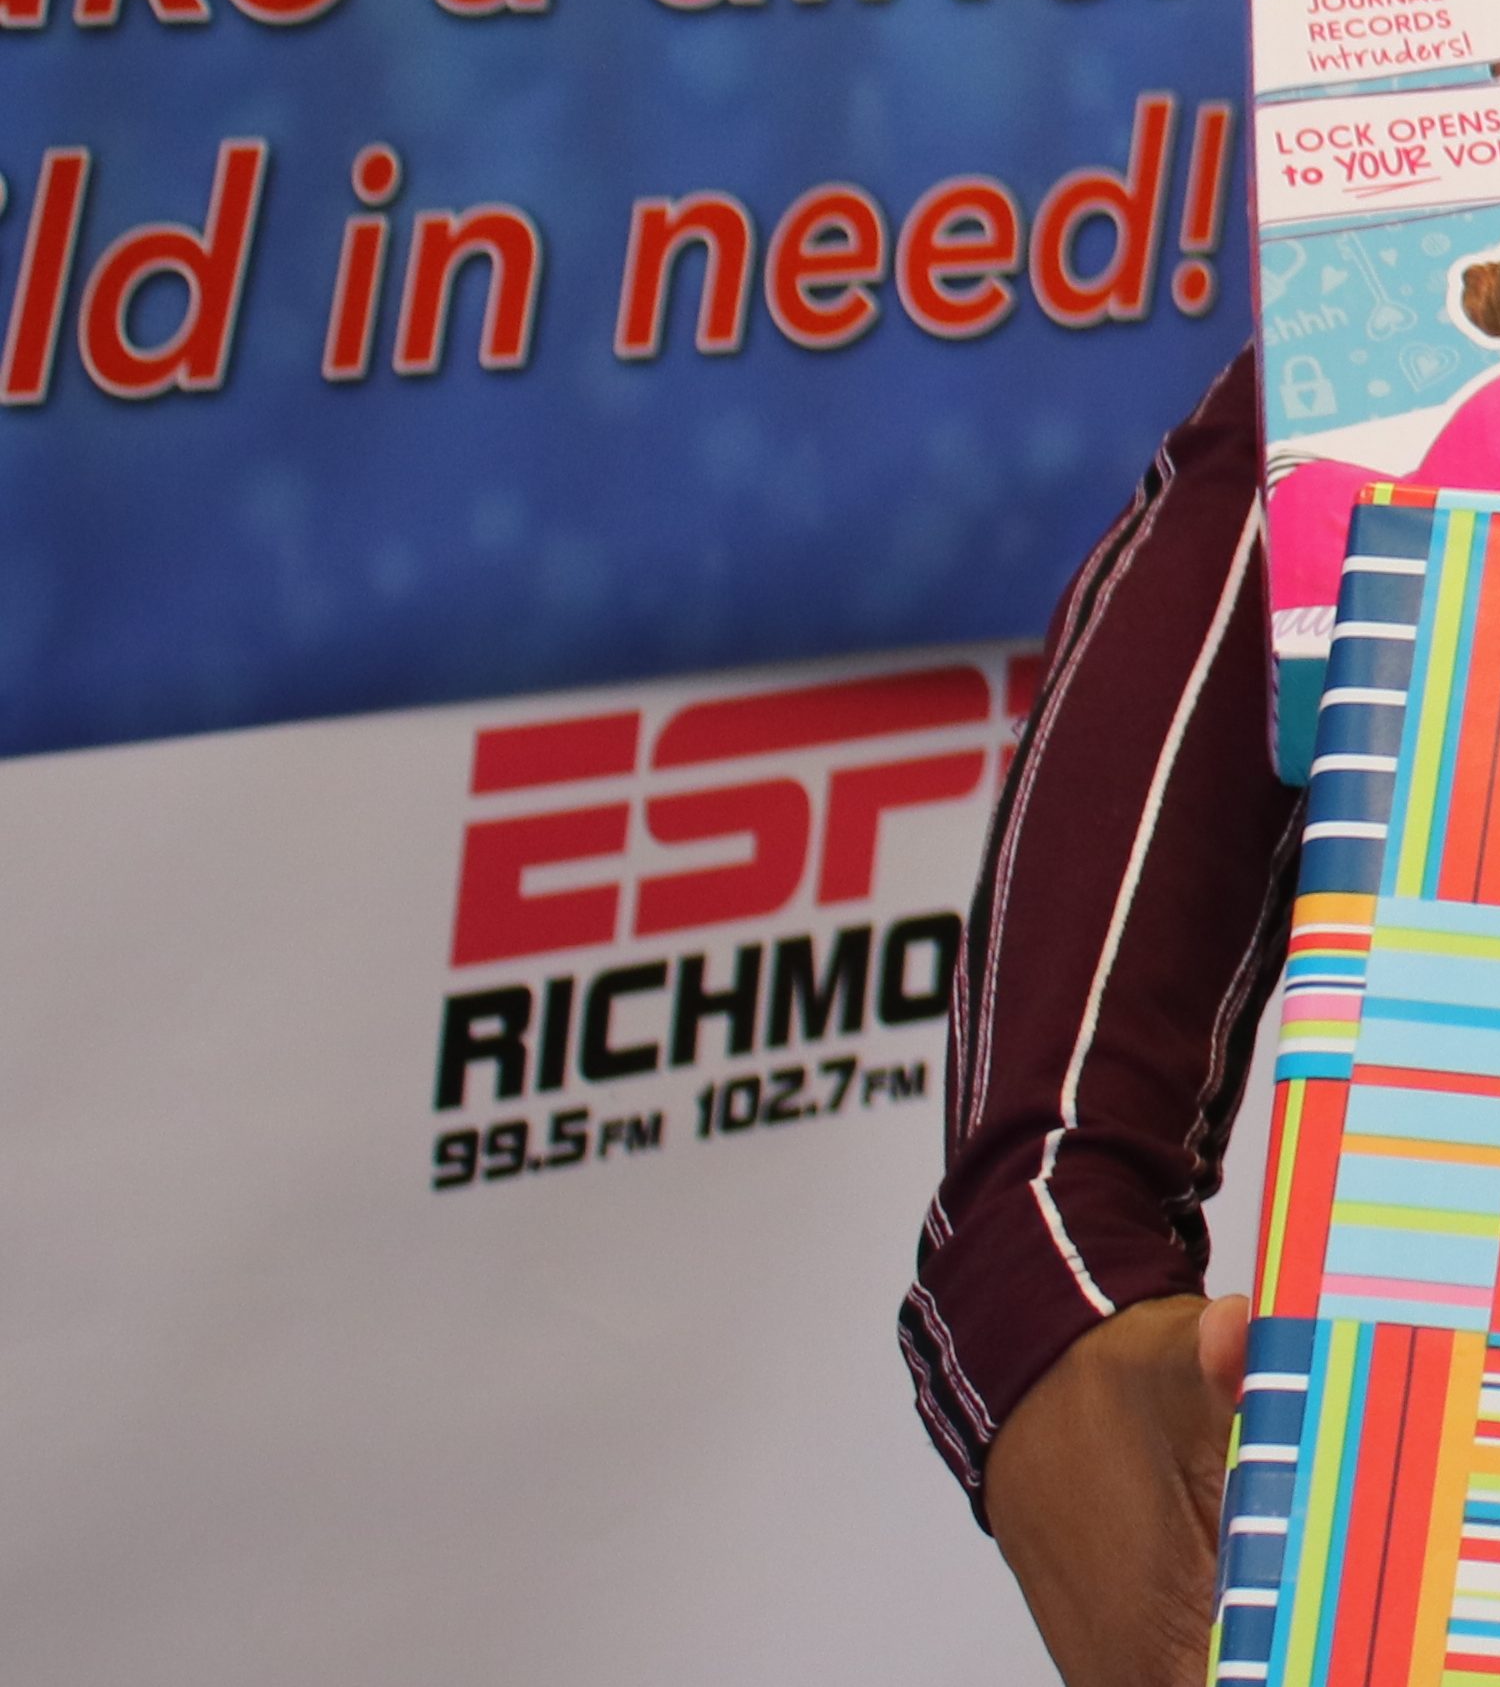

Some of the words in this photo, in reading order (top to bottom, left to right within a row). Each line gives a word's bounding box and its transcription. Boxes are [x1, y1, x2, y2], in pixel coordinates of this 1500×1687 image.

[1308, 9, 1453, 43] RECORDS
[1307, 31, 1473, 73] intruders!
[1275, 121, 1374, 156] LOCK
[1283, 162, 1324, 187] to
[1334, 144, 1432, 183] YOUR
[322, 143, 540, 381] in
[614, 90, 1232, 360] need!
[431, 910, 963, 1115] RICHMO
